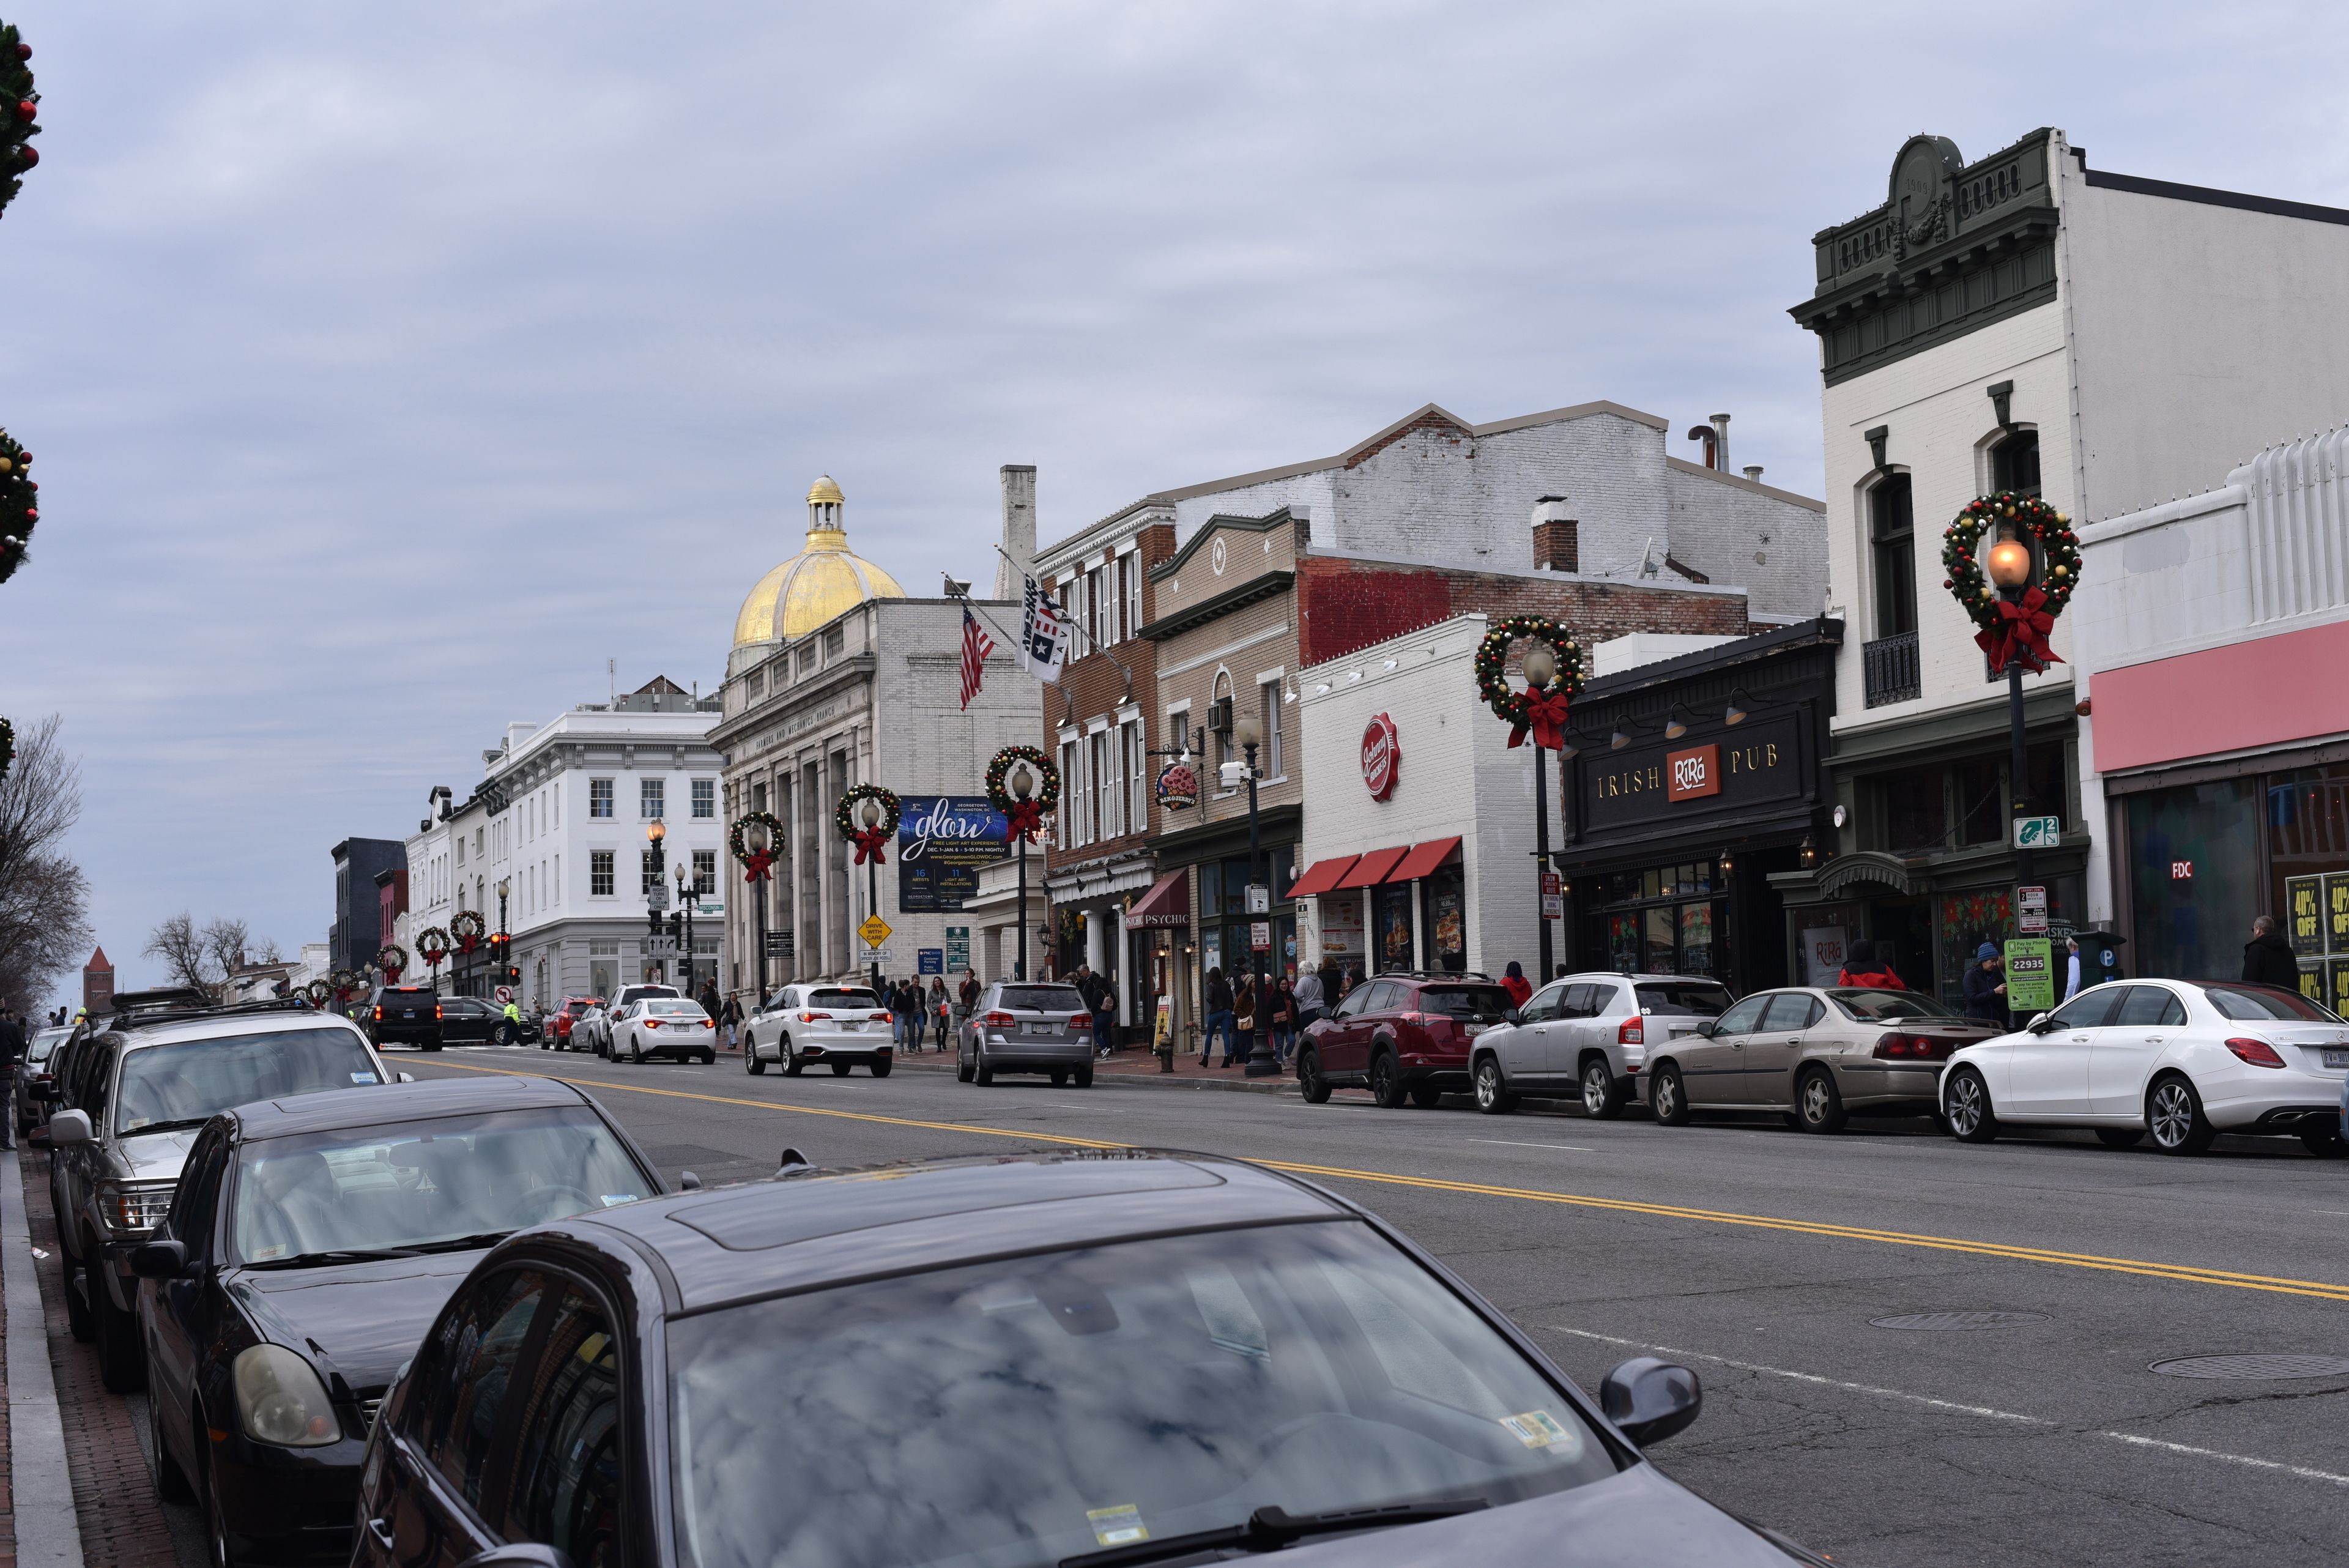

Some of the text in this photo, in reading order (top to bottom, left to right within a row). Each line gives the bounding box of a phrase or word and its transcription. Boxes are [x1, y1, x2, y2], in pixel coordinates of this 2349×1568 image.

[756, 705, 834, 750] FARMERS AND MECHANICS BRANCH
[1364, 734, 1386, 778] Johnny
[1598, 767, 1659, 798] IRISH
[1731, 743, 1777, 774] PUB
[901, 798, 993, 861] glow
[2047, 819, 2055, 830] 2
[2173, 861, 2191, 879] FDC
[2295, 890, 2316, 916] 40%
[1126, 915, 1143, 927] PSYCHIC
[1146, 915, 1189, 924] PSYCHIC
[2297, 916, 2316, 937] OFF
[2014, 960, 2043, 969] 22935
[2300, 973, 2320, 998] 40%
[2337, 972, 2349, 997] 40
[2325, 1053, 2332, 1062] FV
